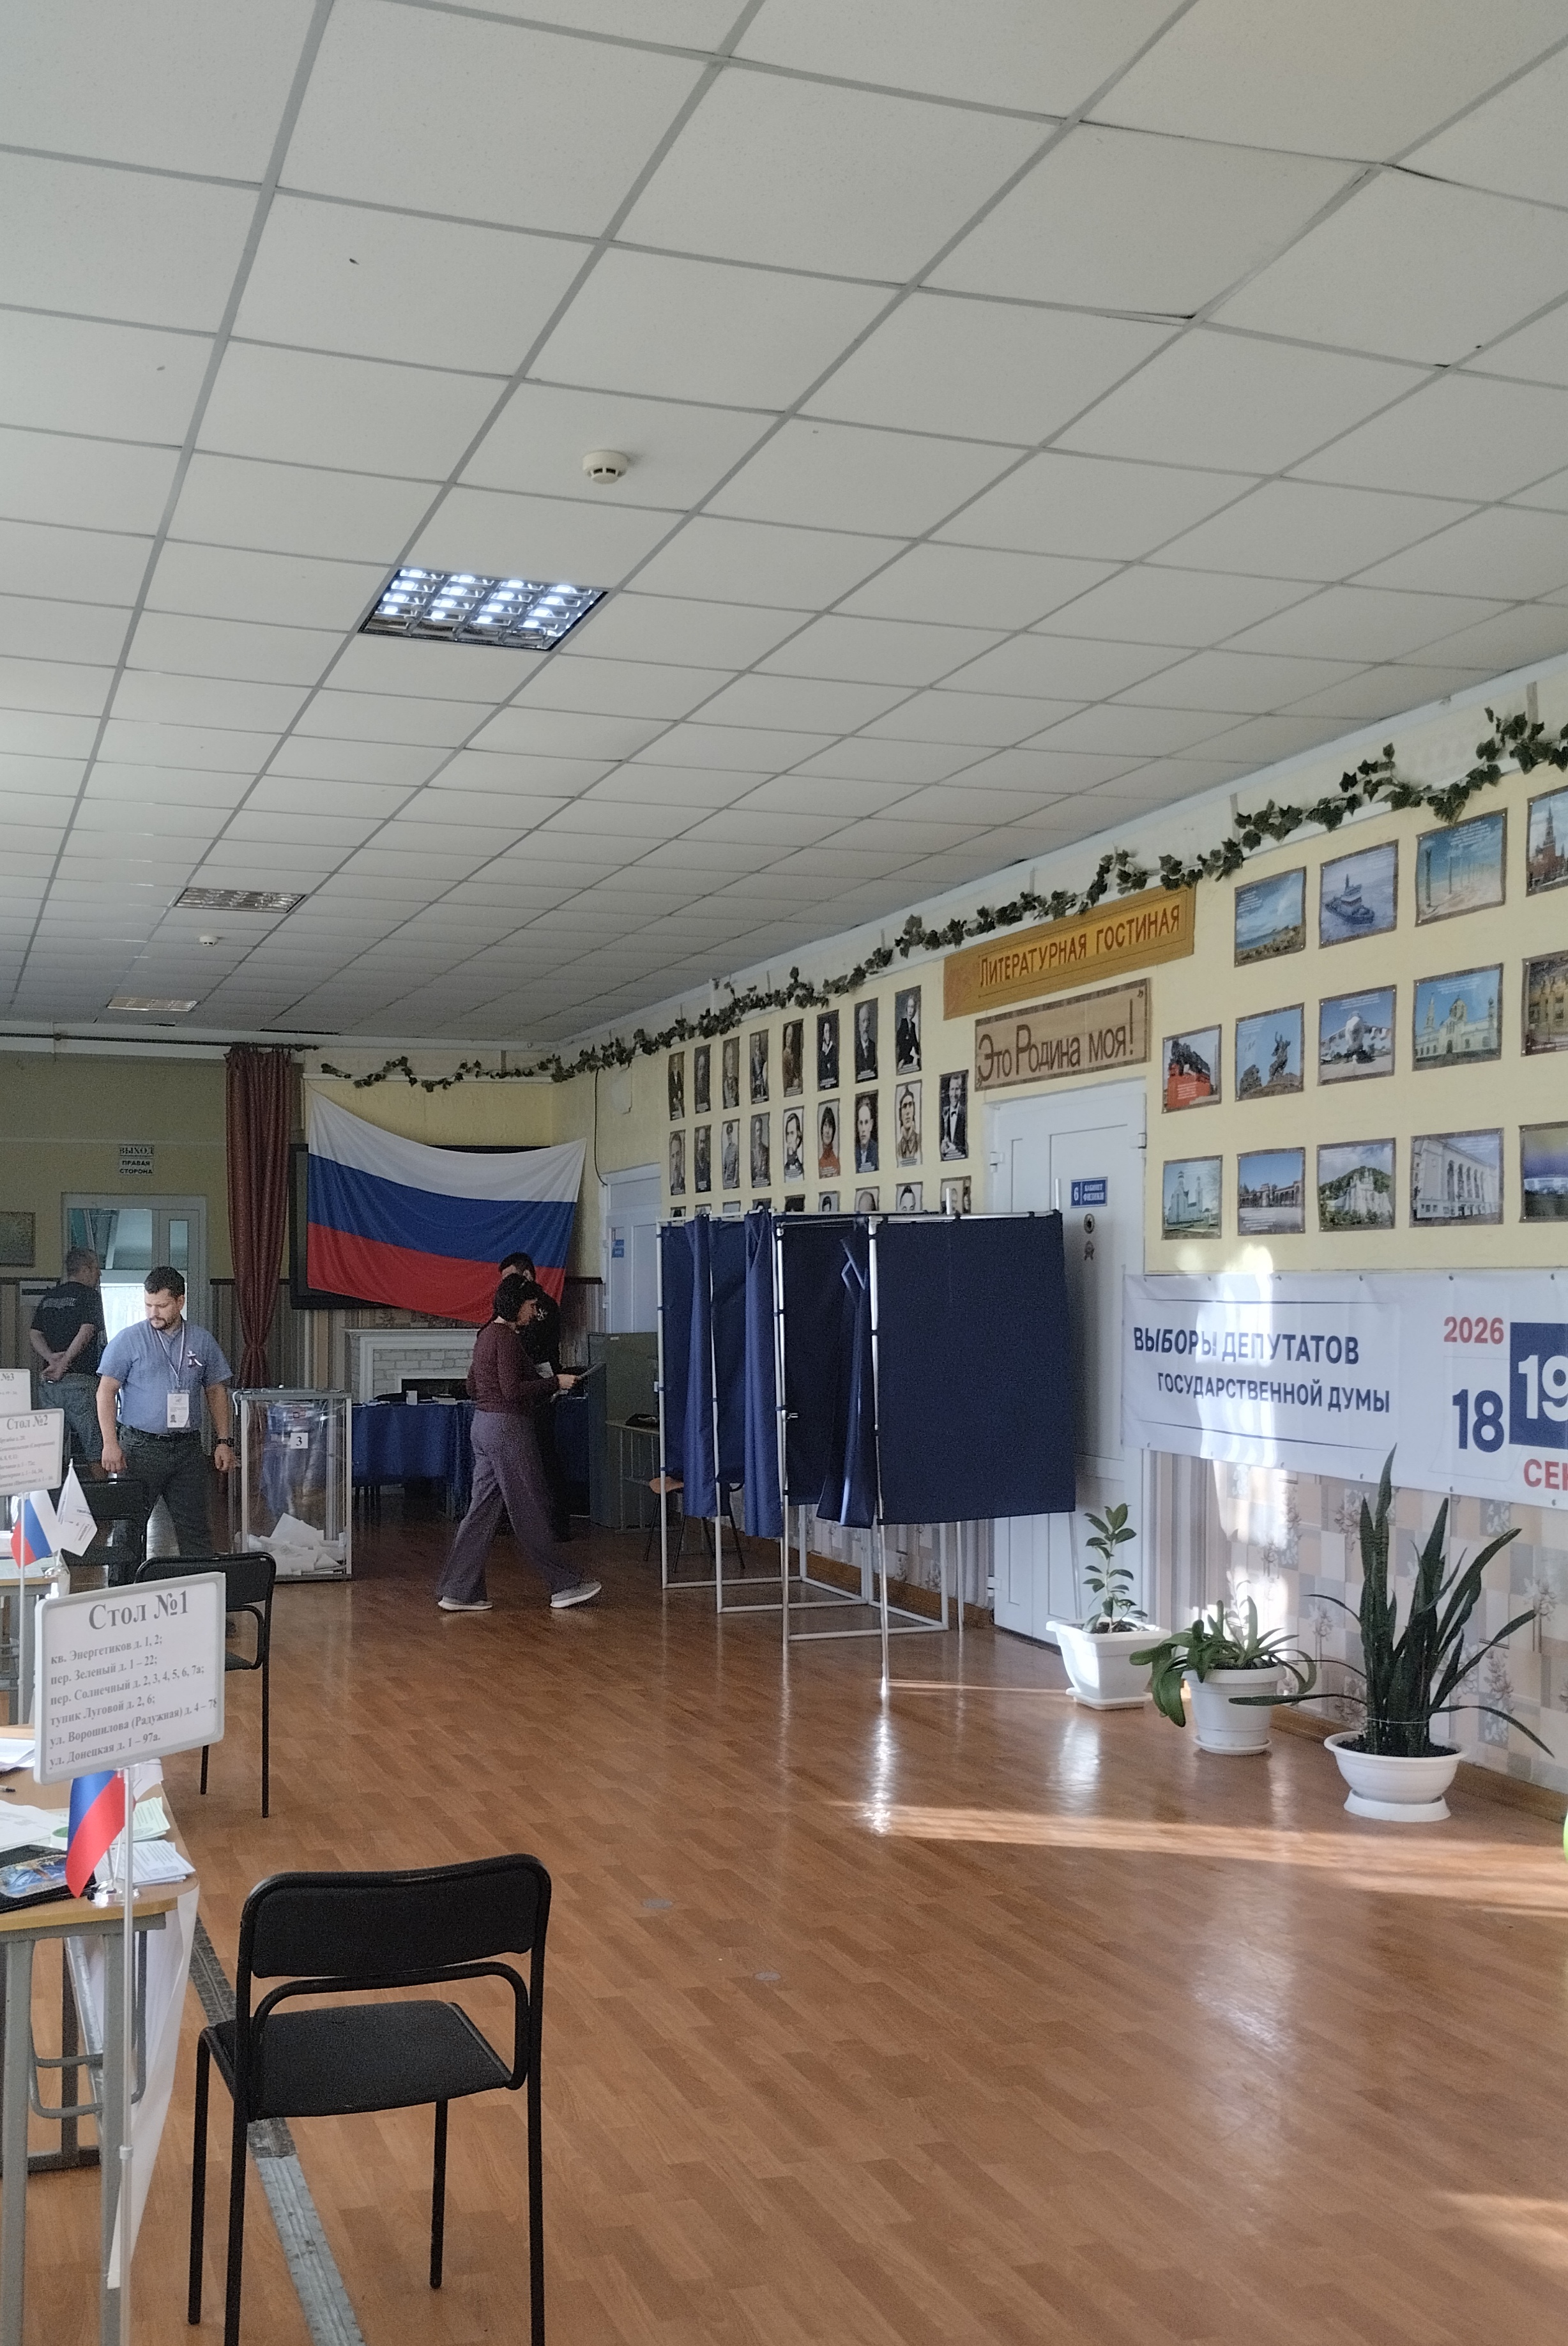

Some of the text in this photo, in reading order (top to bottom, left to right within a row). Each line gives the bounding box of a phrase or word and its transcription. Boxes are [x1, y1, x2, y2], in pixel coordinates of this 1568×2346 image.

[1096, 904, 1180, 954] ГОСТИНАЯ
[1016, 1024, 1080, 1076] Родина
[1074, 1187, 1079, 1201] 6
[1443, 1316, 1504, 1344] 2026
[1134, 1327, 1359, 1365] ВЫБОРЫ ДЕПУТАТОВ
[1157, 1372, 1390, 1413] ГОСУДАРСТВЕННОЙ ДУМЫ
[1518, 1355, 1568, 1422] 19
[6, 1418, 30, 1430] Стол
[1452, 1389, 1504, 1453] 18
[296, 1436, 302, 1446] 3
[89, 1590, 188, 1630] Стол №1
[51, 1656, 66, 1664] кв.
[69, 1643, 132, 1661] Энергетиков
[51, 1675, 72, 1686] пер.
[74, 1663, 116, 1680] Зеленый
[50, 1695, 72, 1706] пер.
[74, 1679, 130, 1700] Солнечный
[50, 1712, 81, 1728] тупик
[83, 1700, 124, 1720] Луговой
[50, 1737, 65, 1749] ул.
[68, 1721, 129, 1742] Ворошилова
[131, 1707, 183, 1730] (Радужная)
[49, 1757, 65, 1770] ул.
[66, 1744, 114, 1764] Донецкая
